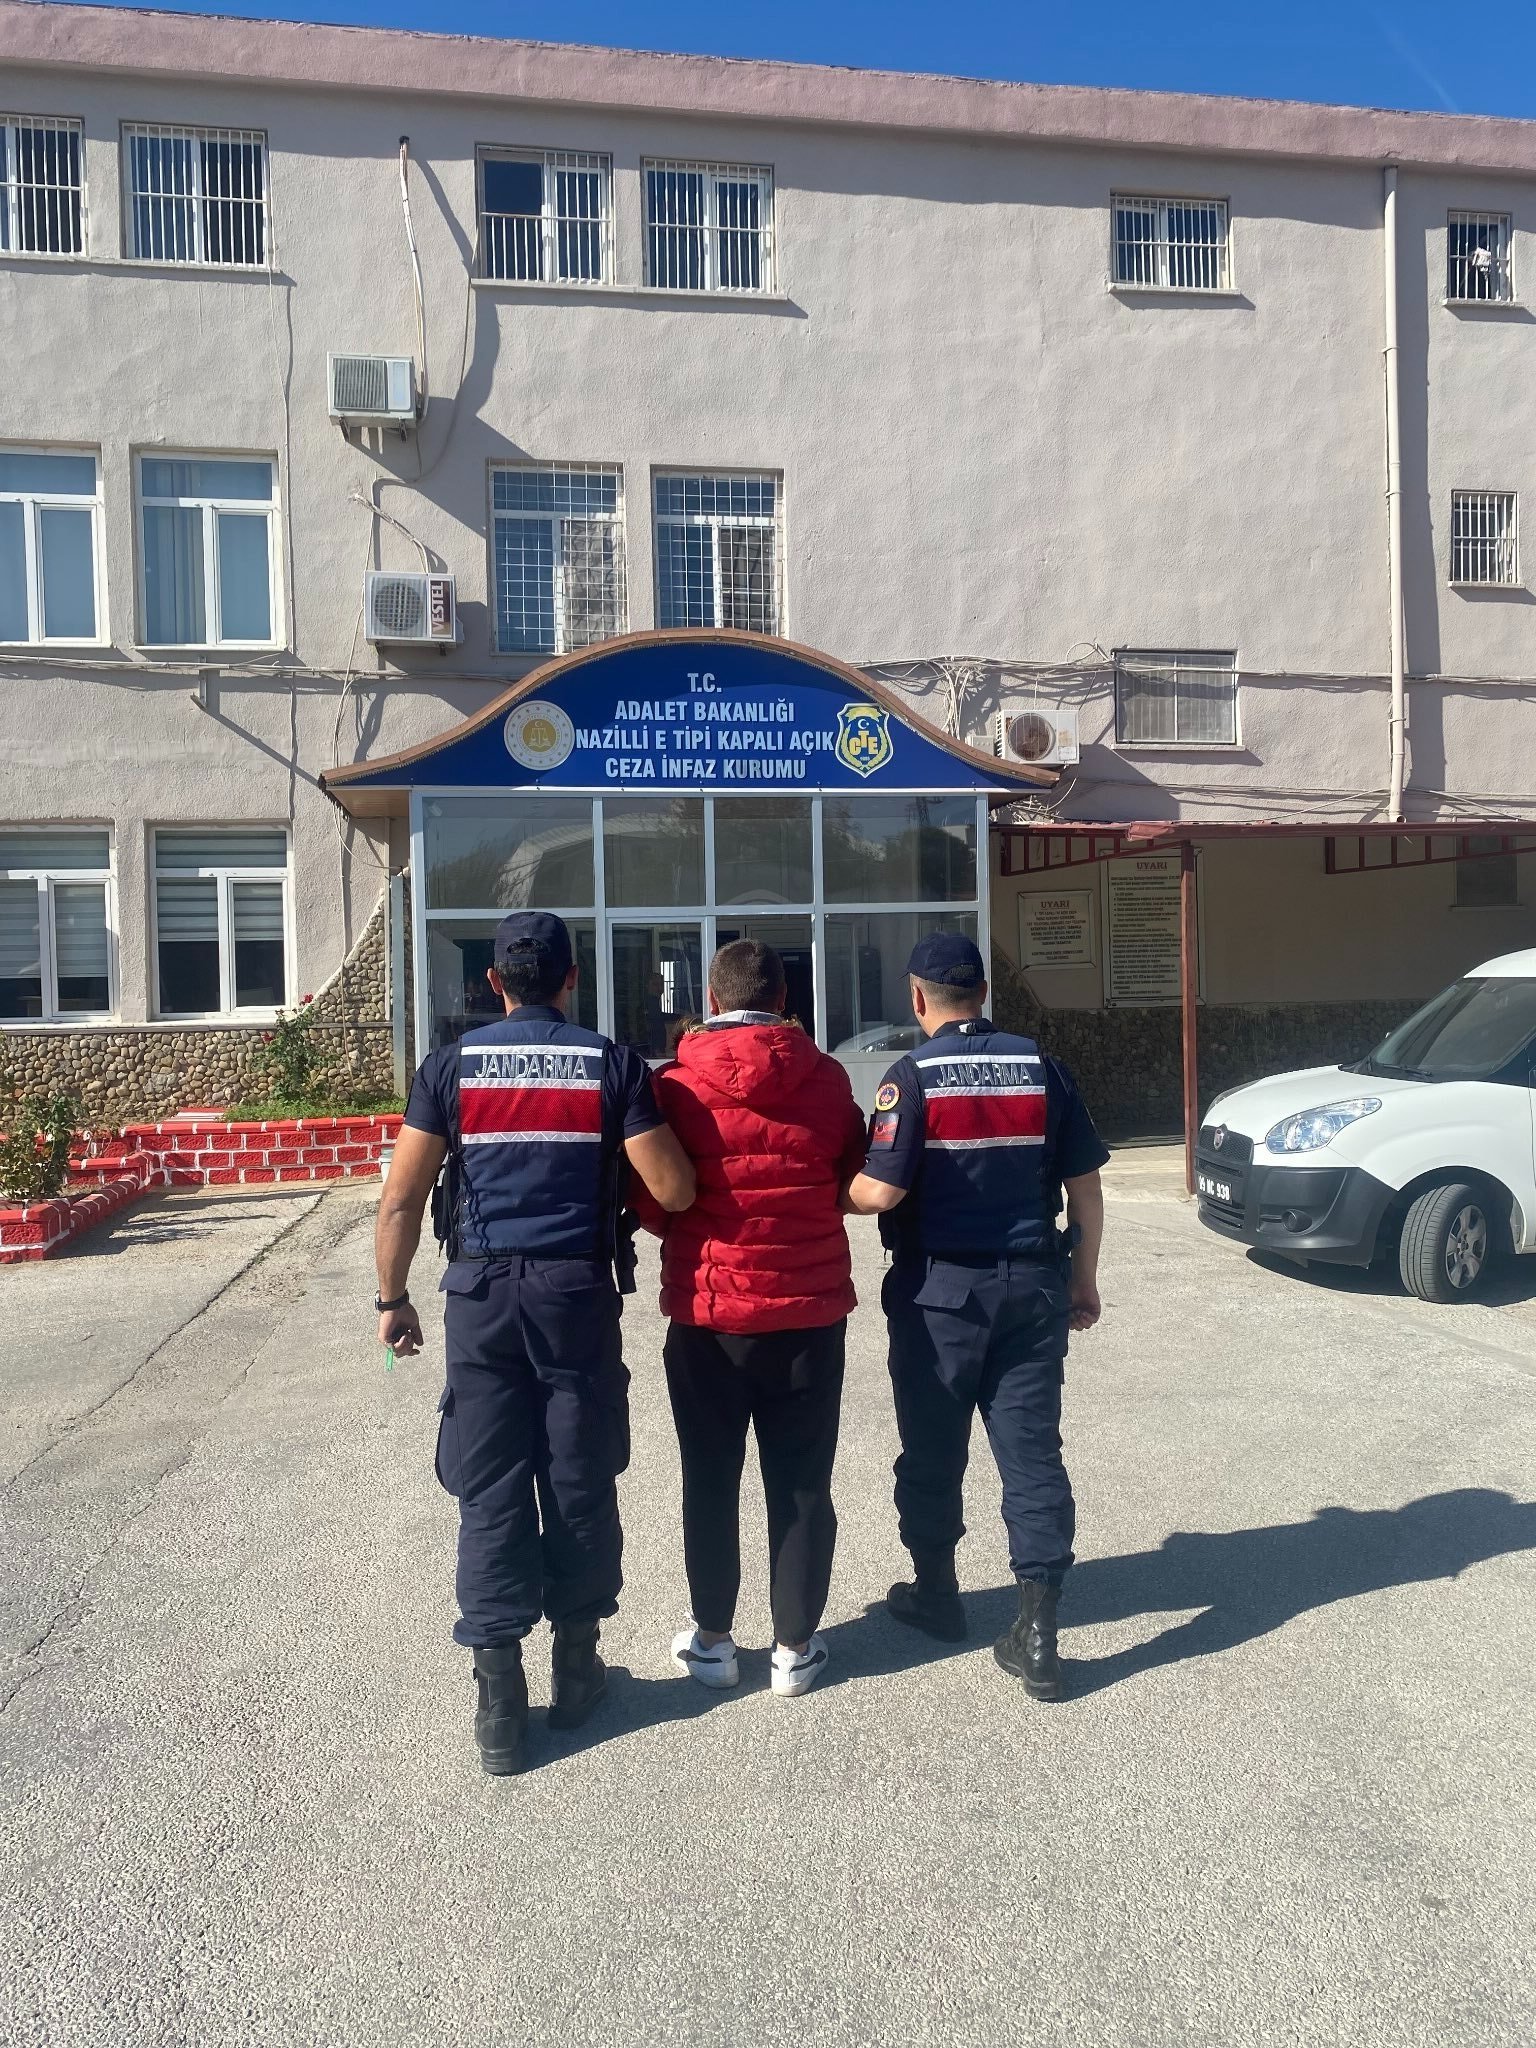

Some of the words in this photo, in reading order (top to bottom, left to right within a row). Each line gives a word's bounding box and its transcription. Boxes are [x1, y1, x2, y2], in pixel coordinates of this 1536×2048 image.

[431, 581, 444, 632] VESTEL
[687, 672, 722, 693] T.C.
[614, 700, 688, 721] ADALET
[694, 698, 795, 722] BAKANLIĞI
[575, 725, 649, 750] NAZİLLİ
[655, 729, 667, 750] E
[672, 725, 711, 750] TİPİ
[718, 730, 783, 751] KAPALI
[789, 730, 834, 756] AÇIK
[605, 757, 656, 778] CEZA
[661, 754, 717, 779] İNFAZ
[723, 759, 806, 780] KURUMU
[1040, 899, 1070, 909] UYARI
[474, 1053, 588, 1080] JANDARMA
[936, 1063, 1034, 1087] JANDARMA
